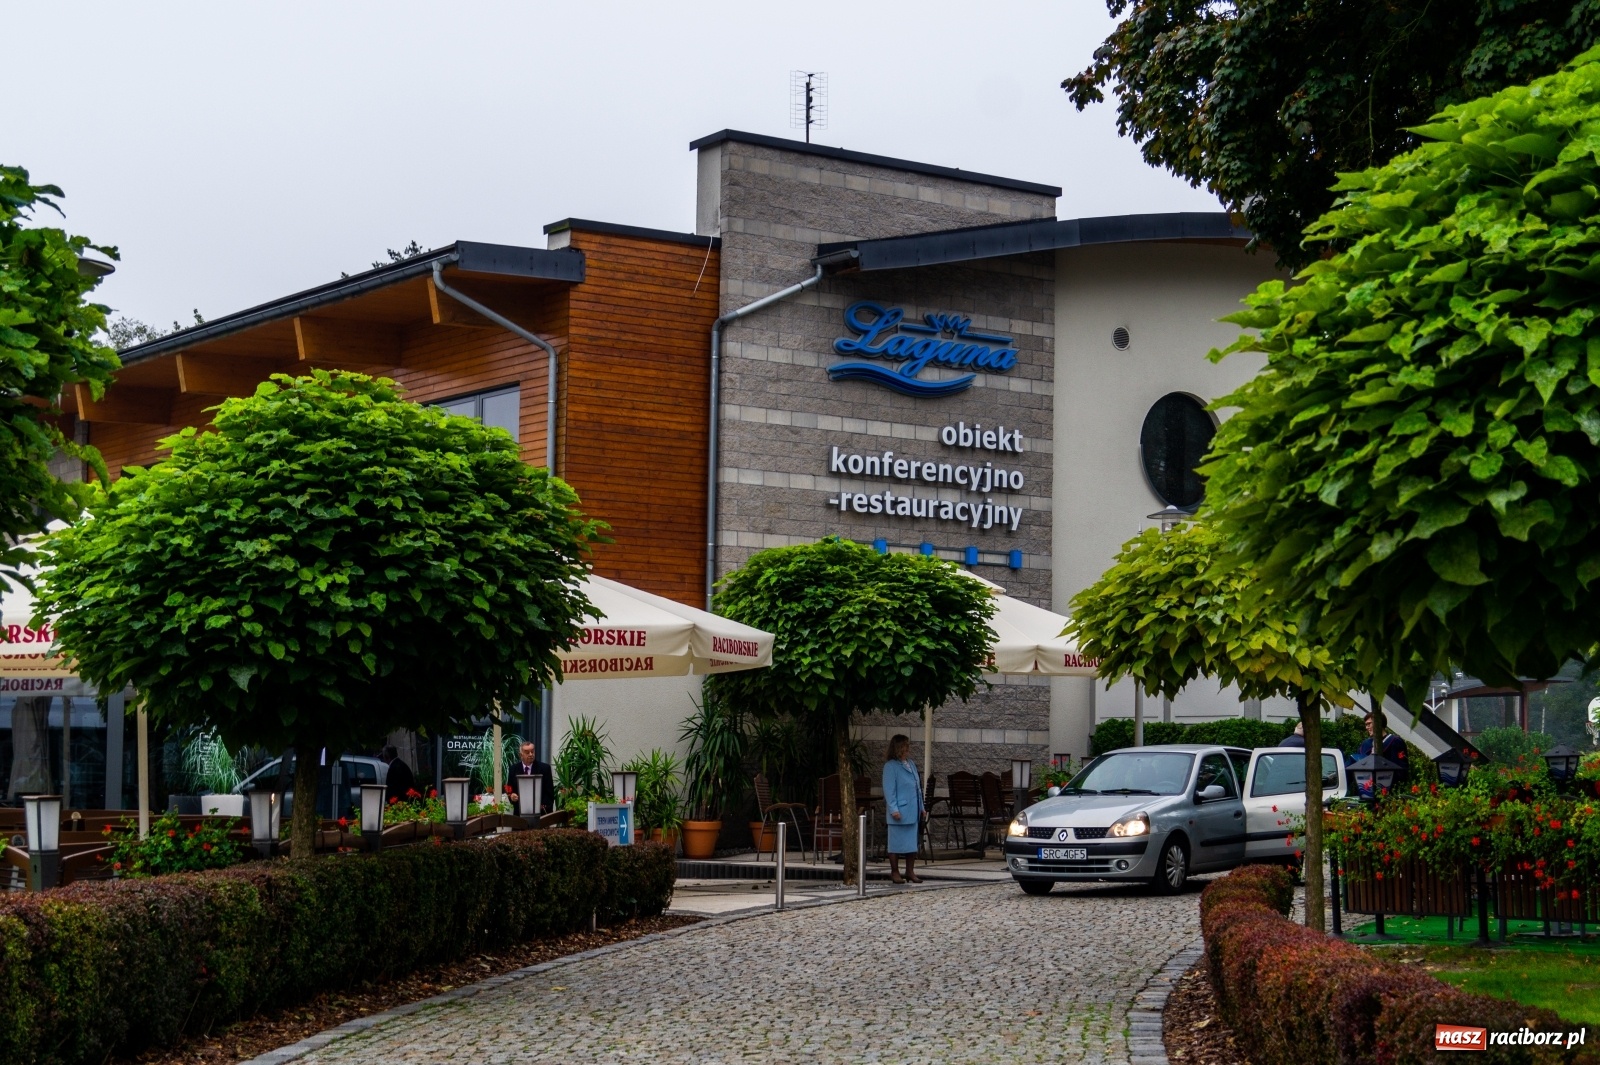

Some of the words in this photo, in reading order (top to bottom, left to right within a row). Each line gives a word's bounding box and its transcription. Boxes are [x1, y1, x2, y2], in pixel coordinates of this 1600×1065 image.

[833, 301, 1020, 378] Laguna
[941, 422, 1023, 453] obiekt
[831, 447, 1024, 491] konferencyjno
[829, 491, 1022, 530] -restauracyjny
[712, 636, 759, 657] RACIBORSKIE
[1043, 849, 1061, 859] SRC
